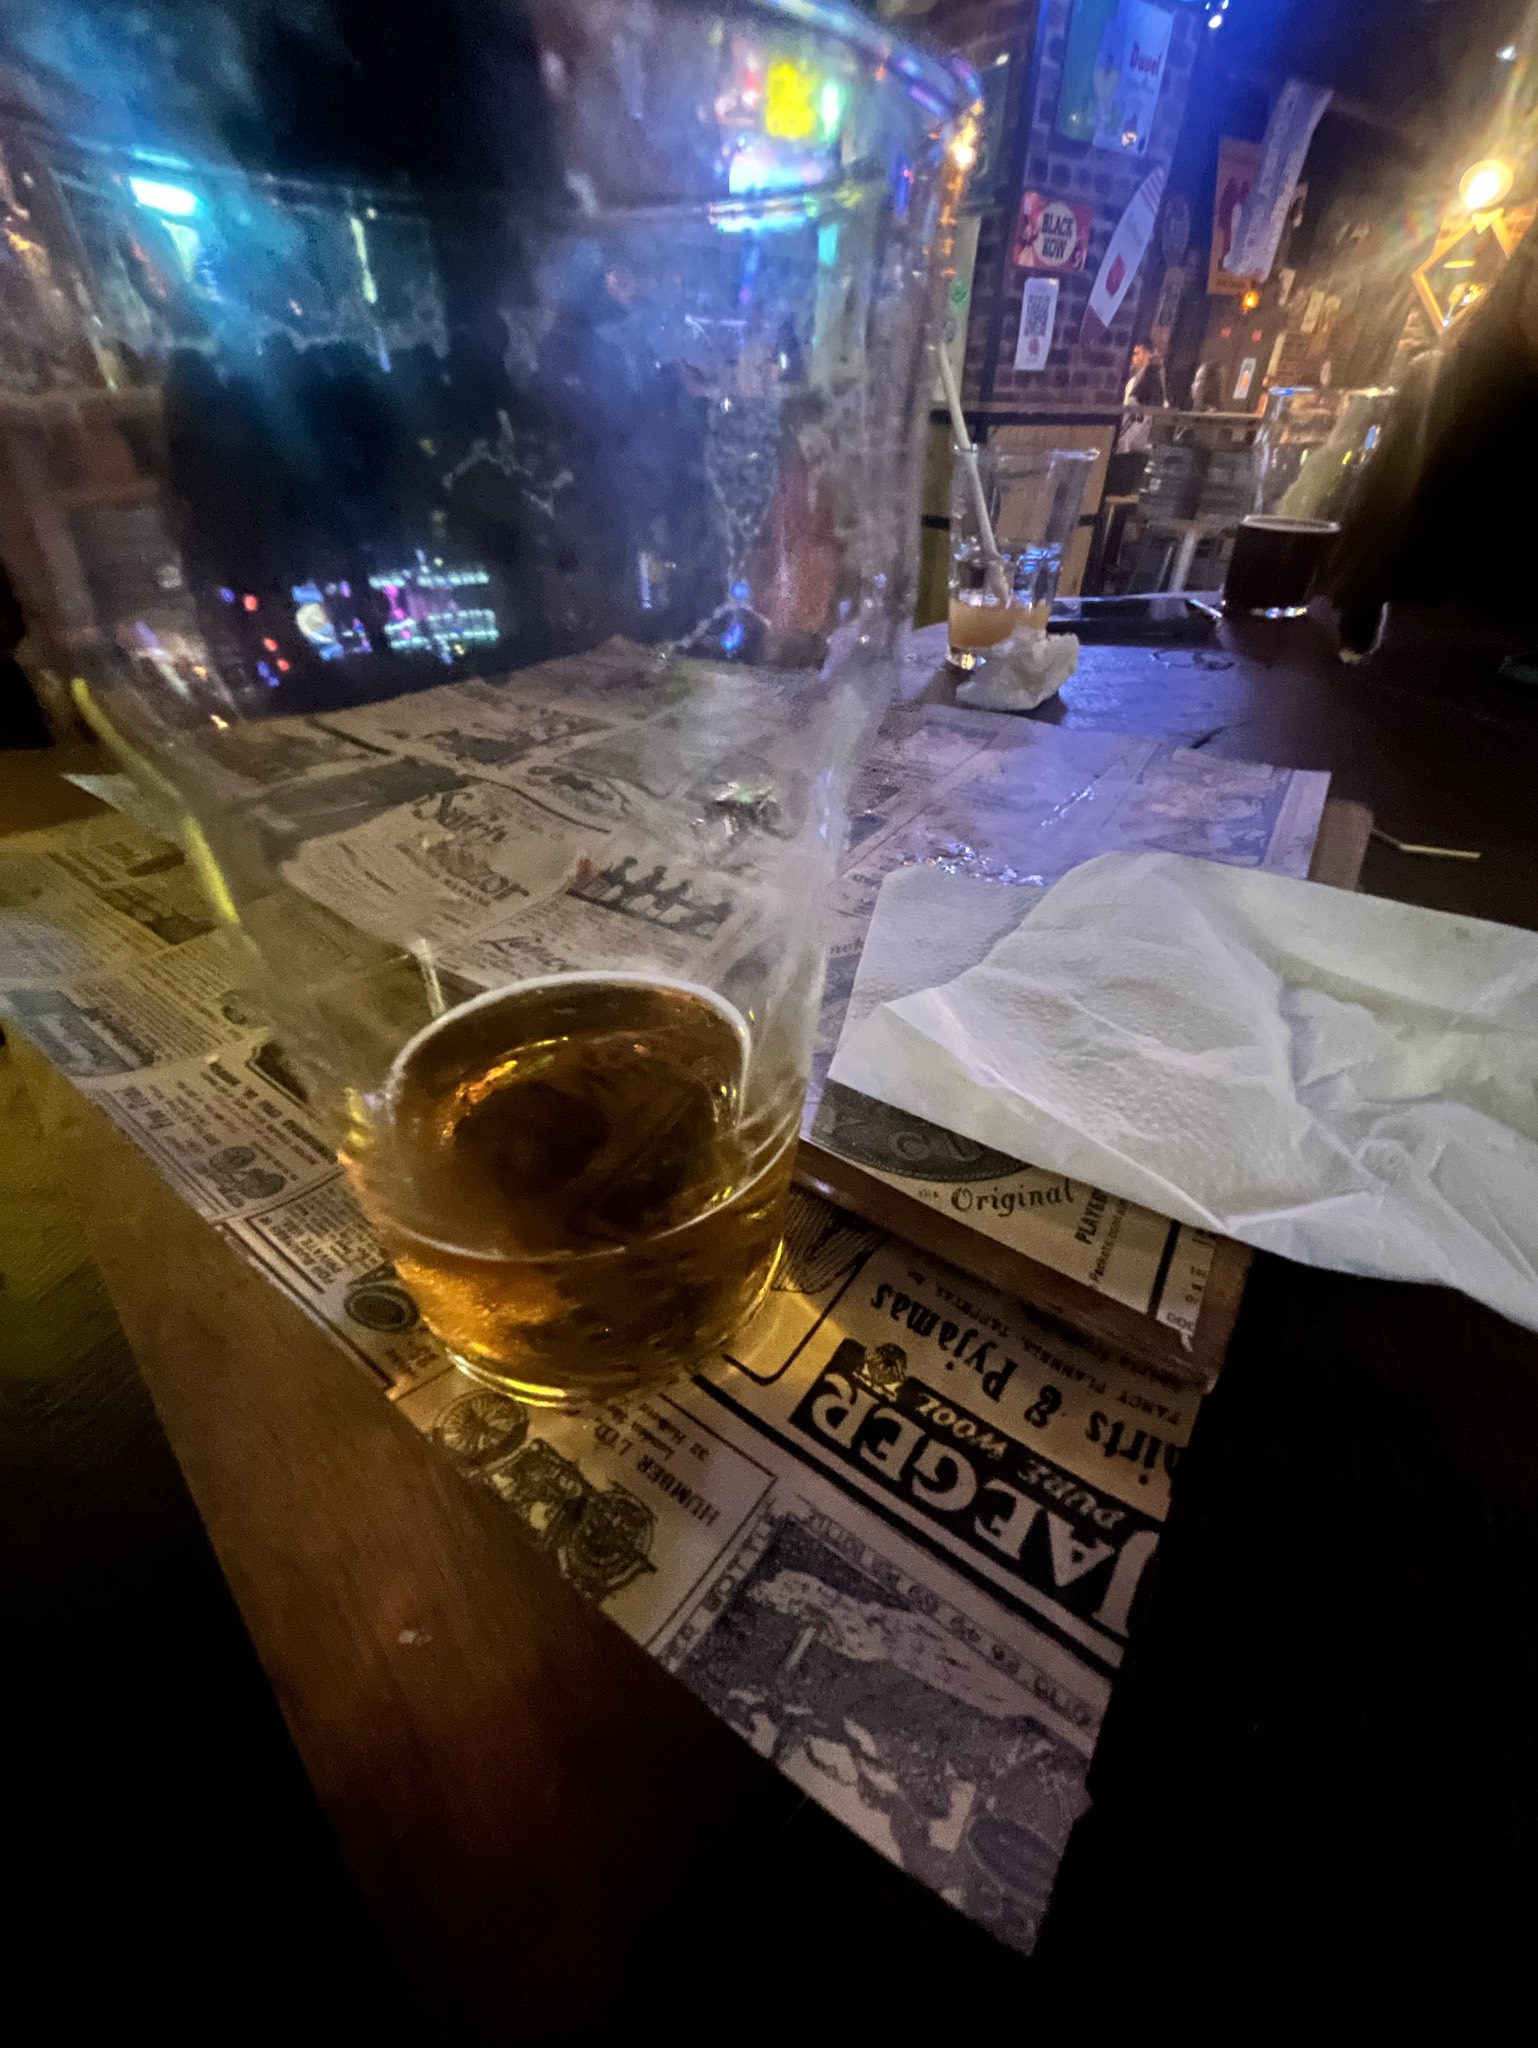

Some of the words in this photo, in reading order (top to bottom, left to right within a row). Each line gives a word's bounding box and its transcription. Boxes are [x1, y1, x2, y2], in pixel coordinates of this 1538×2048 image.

[1041, 212, 1074, 238] BLACK
[951, 1177, 1075, 1219] Original
[870, 1282, 1019, 1402] Pyjamas
[913, 1393, 1008, 1460] WOOL
[1023, 1383, 1063, 1429] &
[637, 1454, 720, 1527] HUMBER
[810, 1372, 1160, 1639] JAEGER
[1017, 1456, 1130, 1531] PURE
